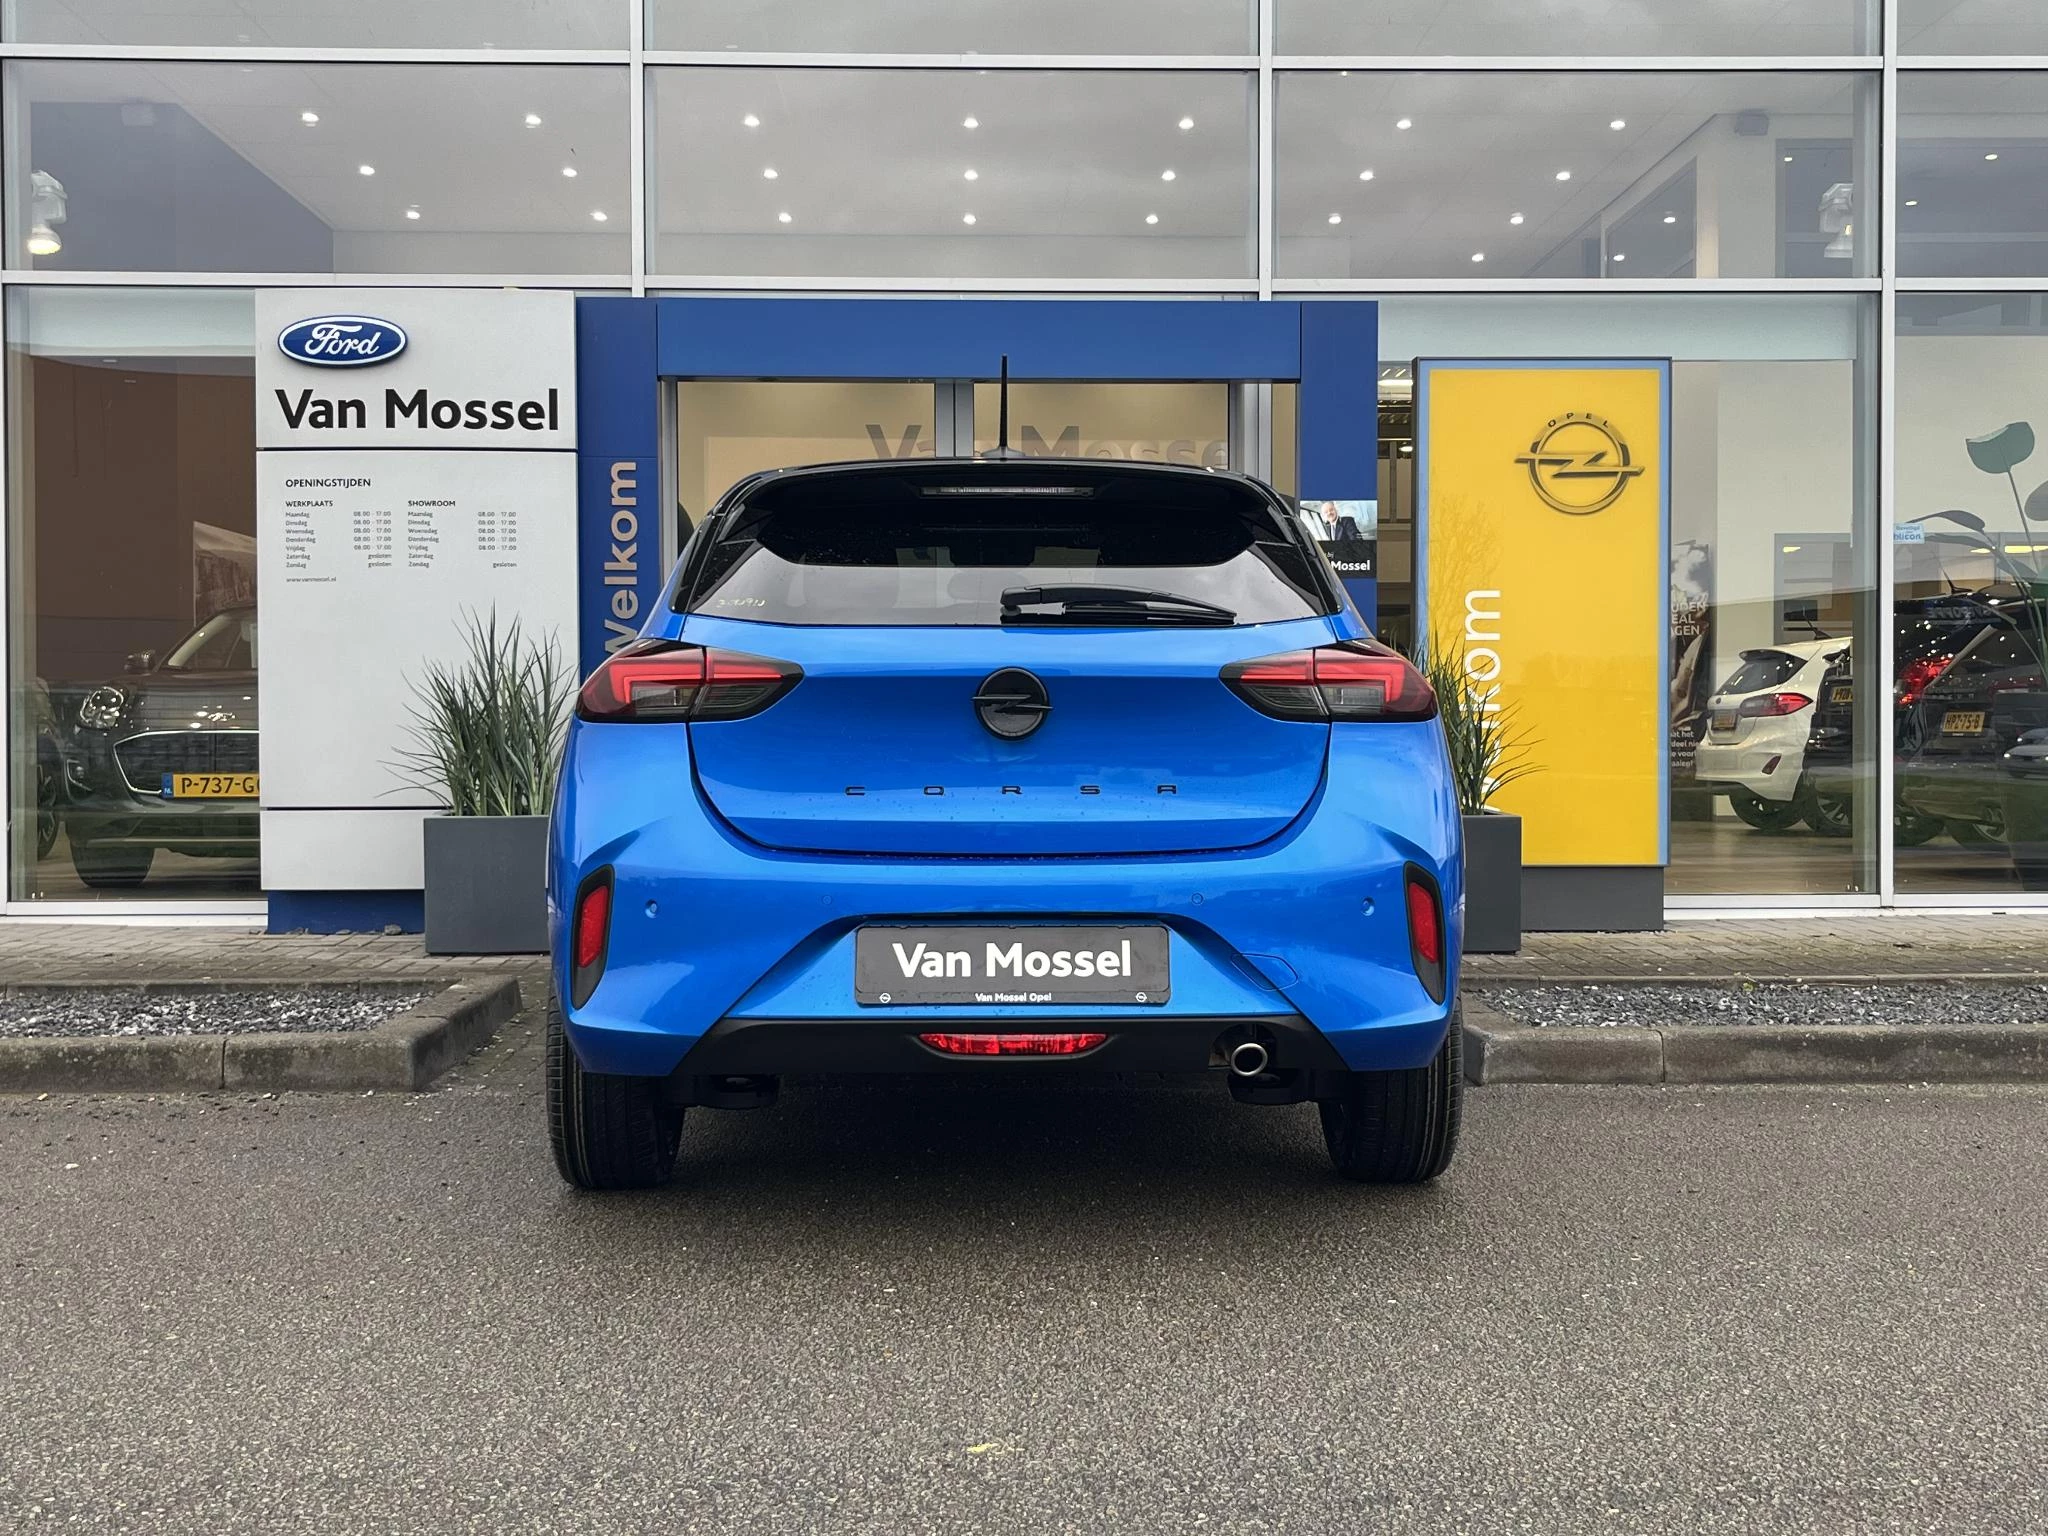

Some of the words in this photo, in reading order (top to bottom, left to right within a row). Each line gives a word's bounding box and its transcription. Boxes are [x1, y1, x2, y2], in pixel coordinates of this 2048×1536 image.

[304, 323, 381, 356] Ford
[275, 389, 366, 429] Van
[384, 388, 559, 431] Mossel
[1547, 412, 1609, 429] OPEL
[1020, 425, 1228, 462] Mosse
[285, 478, 371, 488] OPENINGSTIJDEN
[1330, 560, 1371, 571] Mossel
[845, 784, 1178, 796] CORSA
[892, 943, 971, 977] Van
[986, 940, 1131, 977] Mossel
[975, 993, 993, 1001] Van
[994, 992, 1026, 1001] Mossel
[1028, 992, 1051, 1002] Opel
